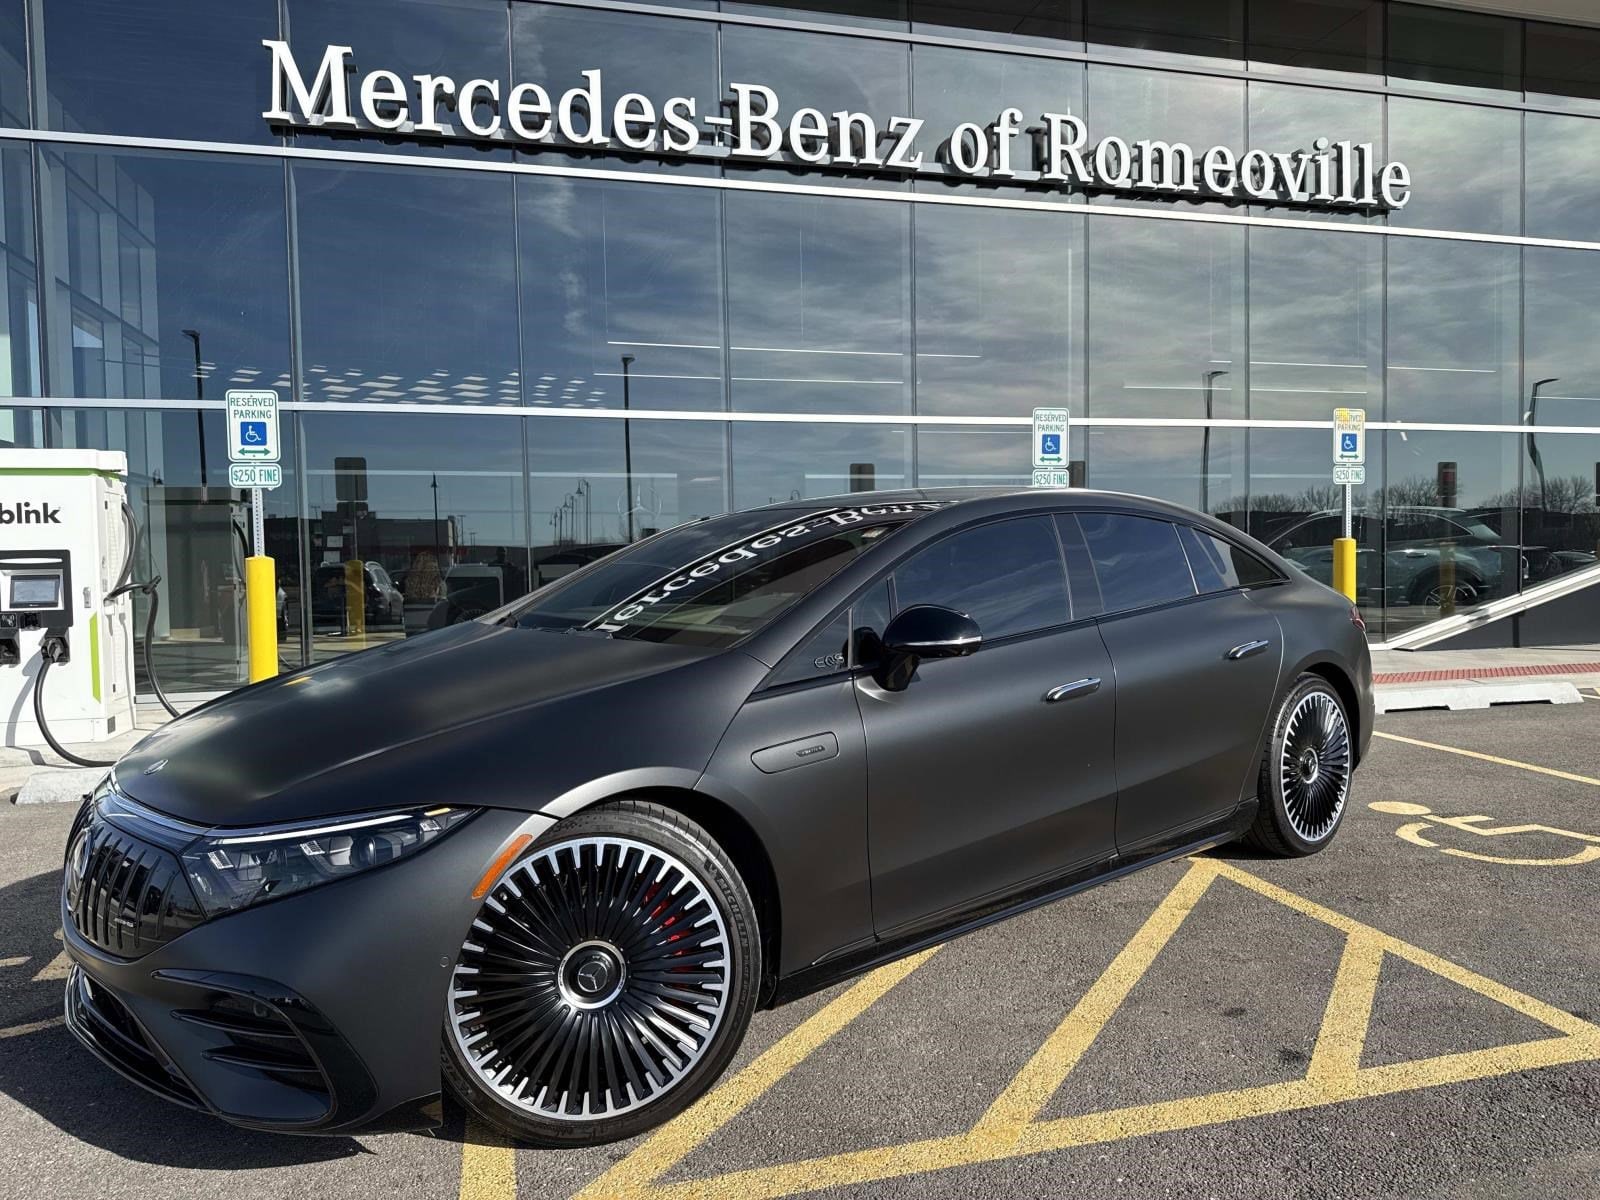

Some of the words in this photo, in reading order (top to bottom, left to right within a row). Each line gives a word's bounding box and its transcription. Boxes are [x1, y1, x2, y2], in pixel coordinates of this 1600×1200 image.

[262, 39, 925, 170] Mercedes-Benz
[950, 107, 1023, 177] of
[1041, 112, 1412, 208] Romeoville
[230, 397, 274, 407] RESERVED
[233, 409, 272, 419] PARKING
[1036, 413, 1066, 423] RESERVED
[1038, 423, 1065, 432] PARKING
[233, 469, 256, 482] $250
[259, 469, 278, 482] FINE
[1035, 473, 1051, 485] $250
[1053, 473, 1066, 485] FINE
[0, 501, 61, 524] blink
[814, 653, 845, 670] EQS
[716, 876, 748, 947] MICHELIN
